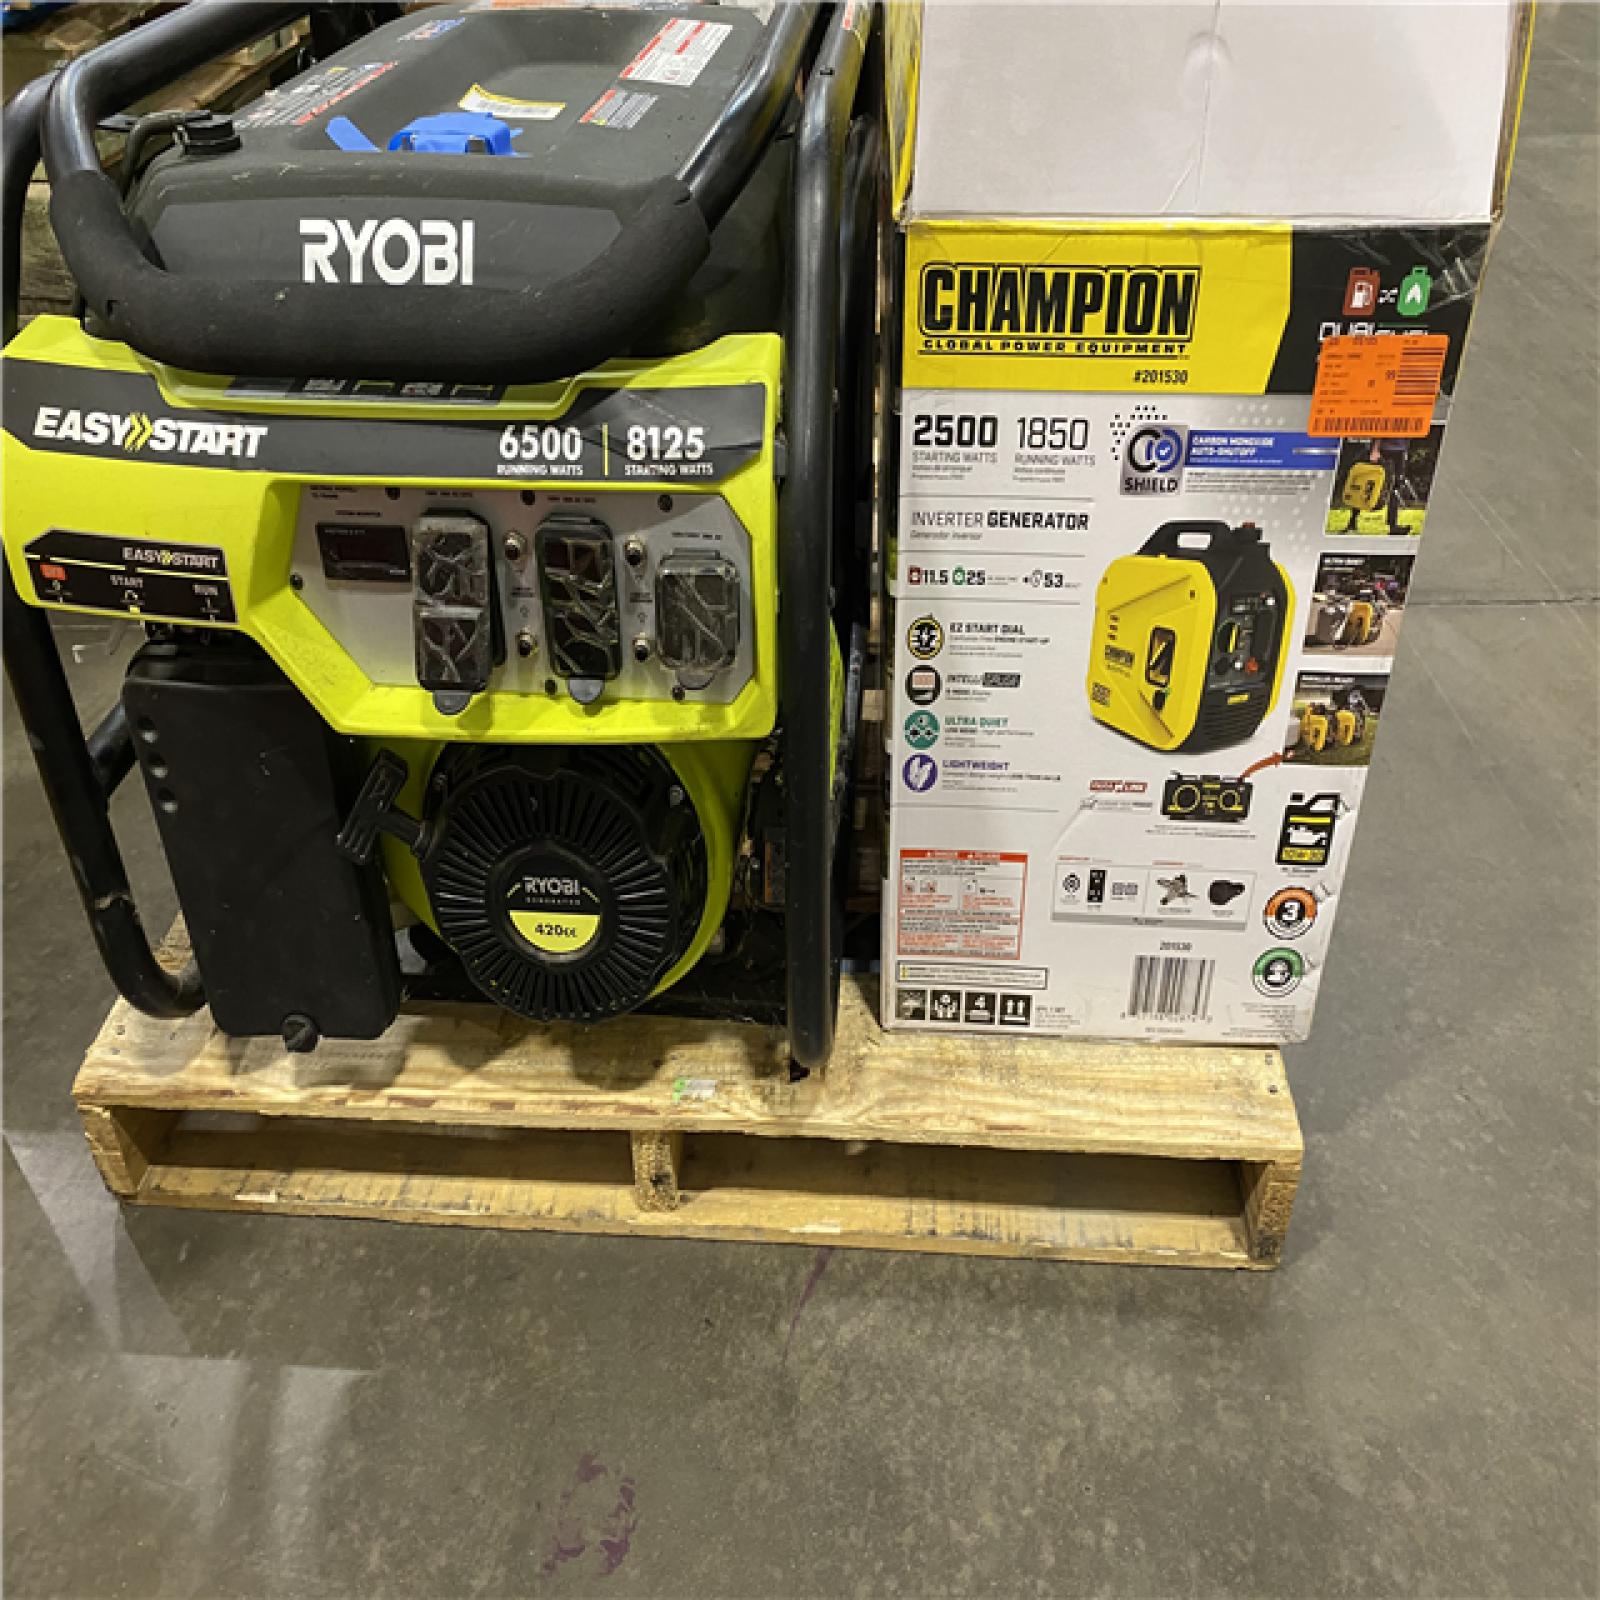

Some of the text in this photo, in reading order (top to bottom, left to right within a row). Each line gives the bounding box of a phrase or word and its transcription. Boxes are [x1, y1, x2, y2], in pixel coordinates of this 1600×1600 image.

[300, 219, 474, 285] RYOBI
[922, 266, 1198, 338] CHAMPION
[923, 340, 1187, 355] GLOBAL POWER EQUIPMENT
[1133, 369, 1189, 386] #201530
[33, 406, 269, 458] EASY START
[913, 414, 999, 448] 2500
[1016, 416, 1089, 450] 1850
[499, 424, 583, 461] 6500
[626, 424, 706, 461] 8125
[911, 452, 998, 464] STARTING WATTS
[1014, 454, 1096, 467] RUNNING WATTS
[1123, 477, 1178, 494] SHIELD
[912, 511, 1089, 531] INVERTER GENERATOR
[923, 569, 949, 586] 11.5
[966, 569, 986, 586] 25
[1044, 572, 1064, 588] 53
[521, 876, 581, 896] RYOBI
[1281, 901, 1300, 922] 3
